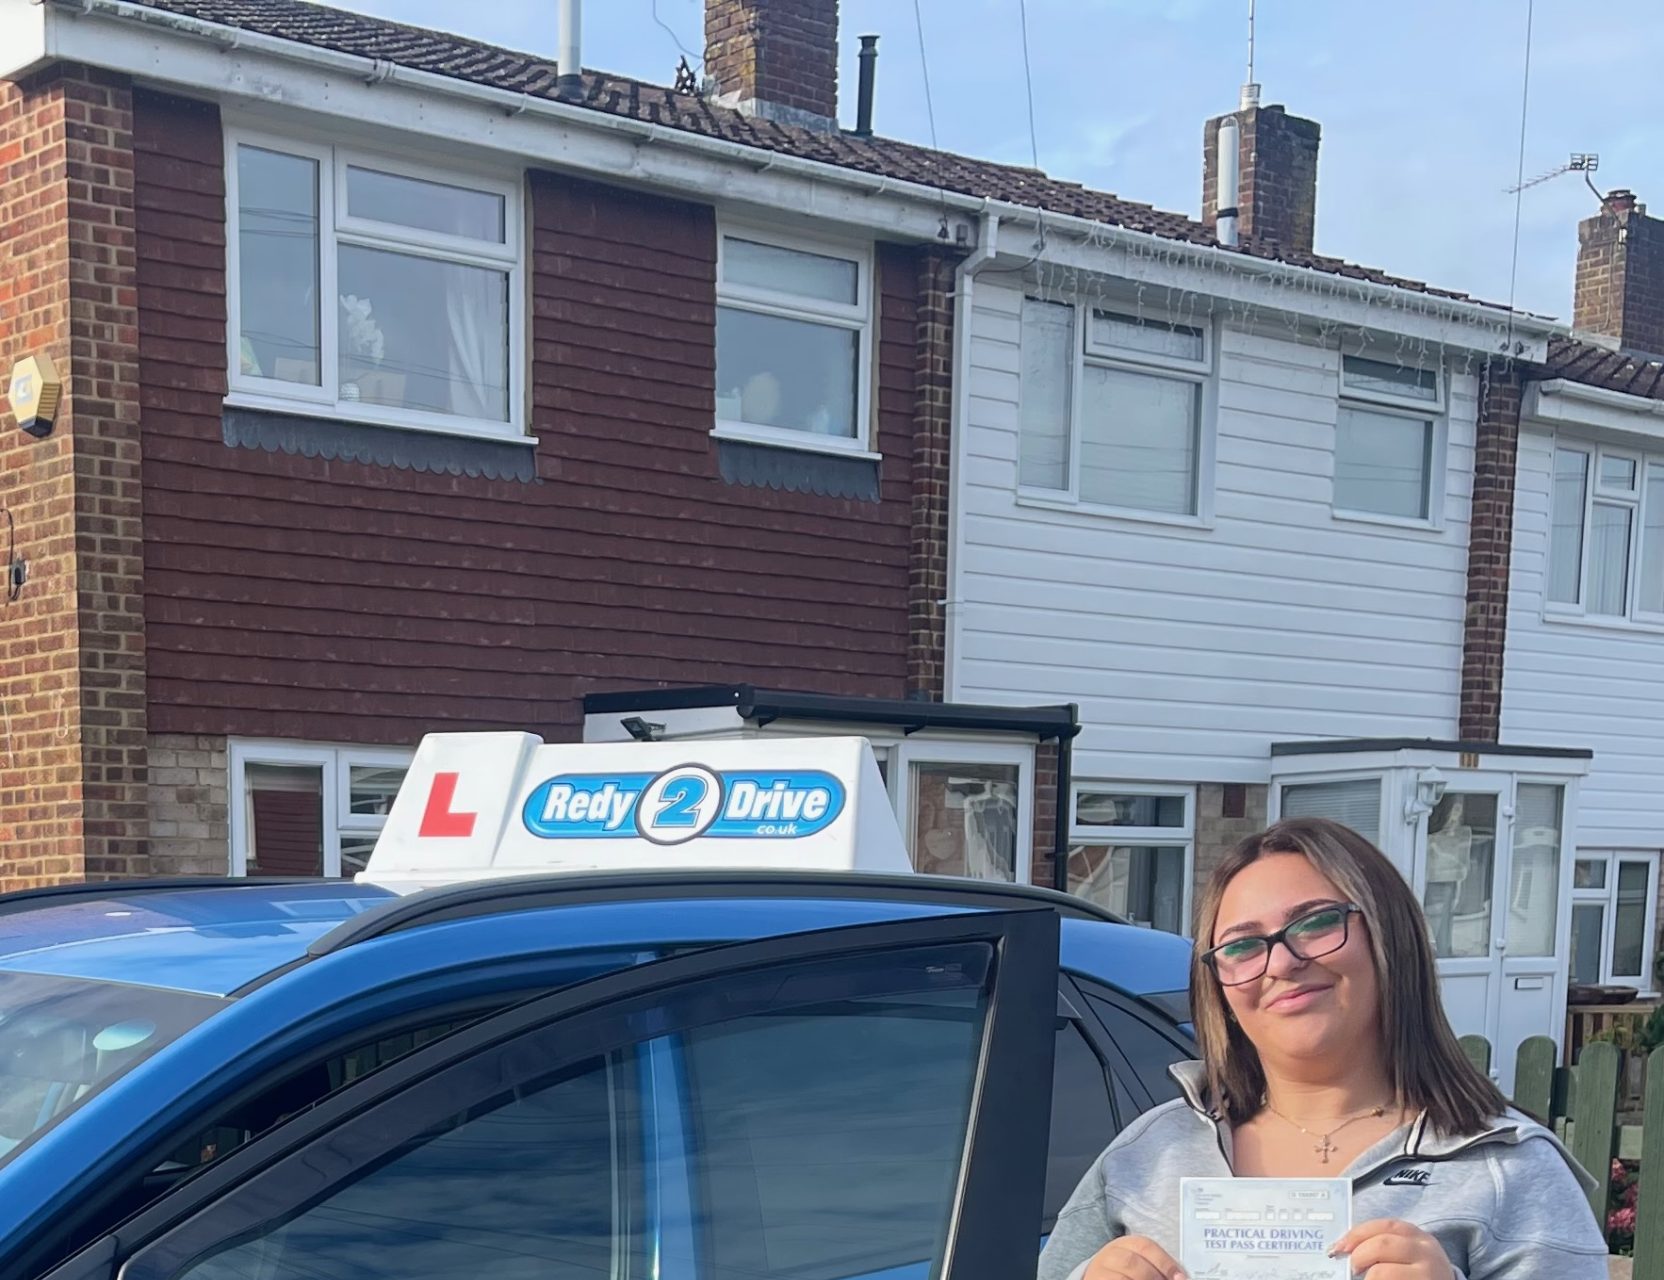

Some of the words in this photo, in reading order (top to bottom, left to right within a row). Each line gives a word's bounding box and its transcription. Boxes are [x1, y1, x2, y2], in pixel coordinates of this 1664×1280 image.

[418, 772, 478, 838] L
[541, 783, 638, 829] Redy
[652, 775, 709, 827] 2
[724, 780, 830, 821] Drive
[1394, 1169, 1431, 1181] NIKE
[1204, 1228, 1266, 1239] PRACTICAL
[1270, 1228, 1324, 1240] DRIVING
[1204, 1239, 1228, 1249] TEST
[1230, 1240, 1255, 1250] PASS
[1257, 1240, 1324, 1251] CERTIFICATE
